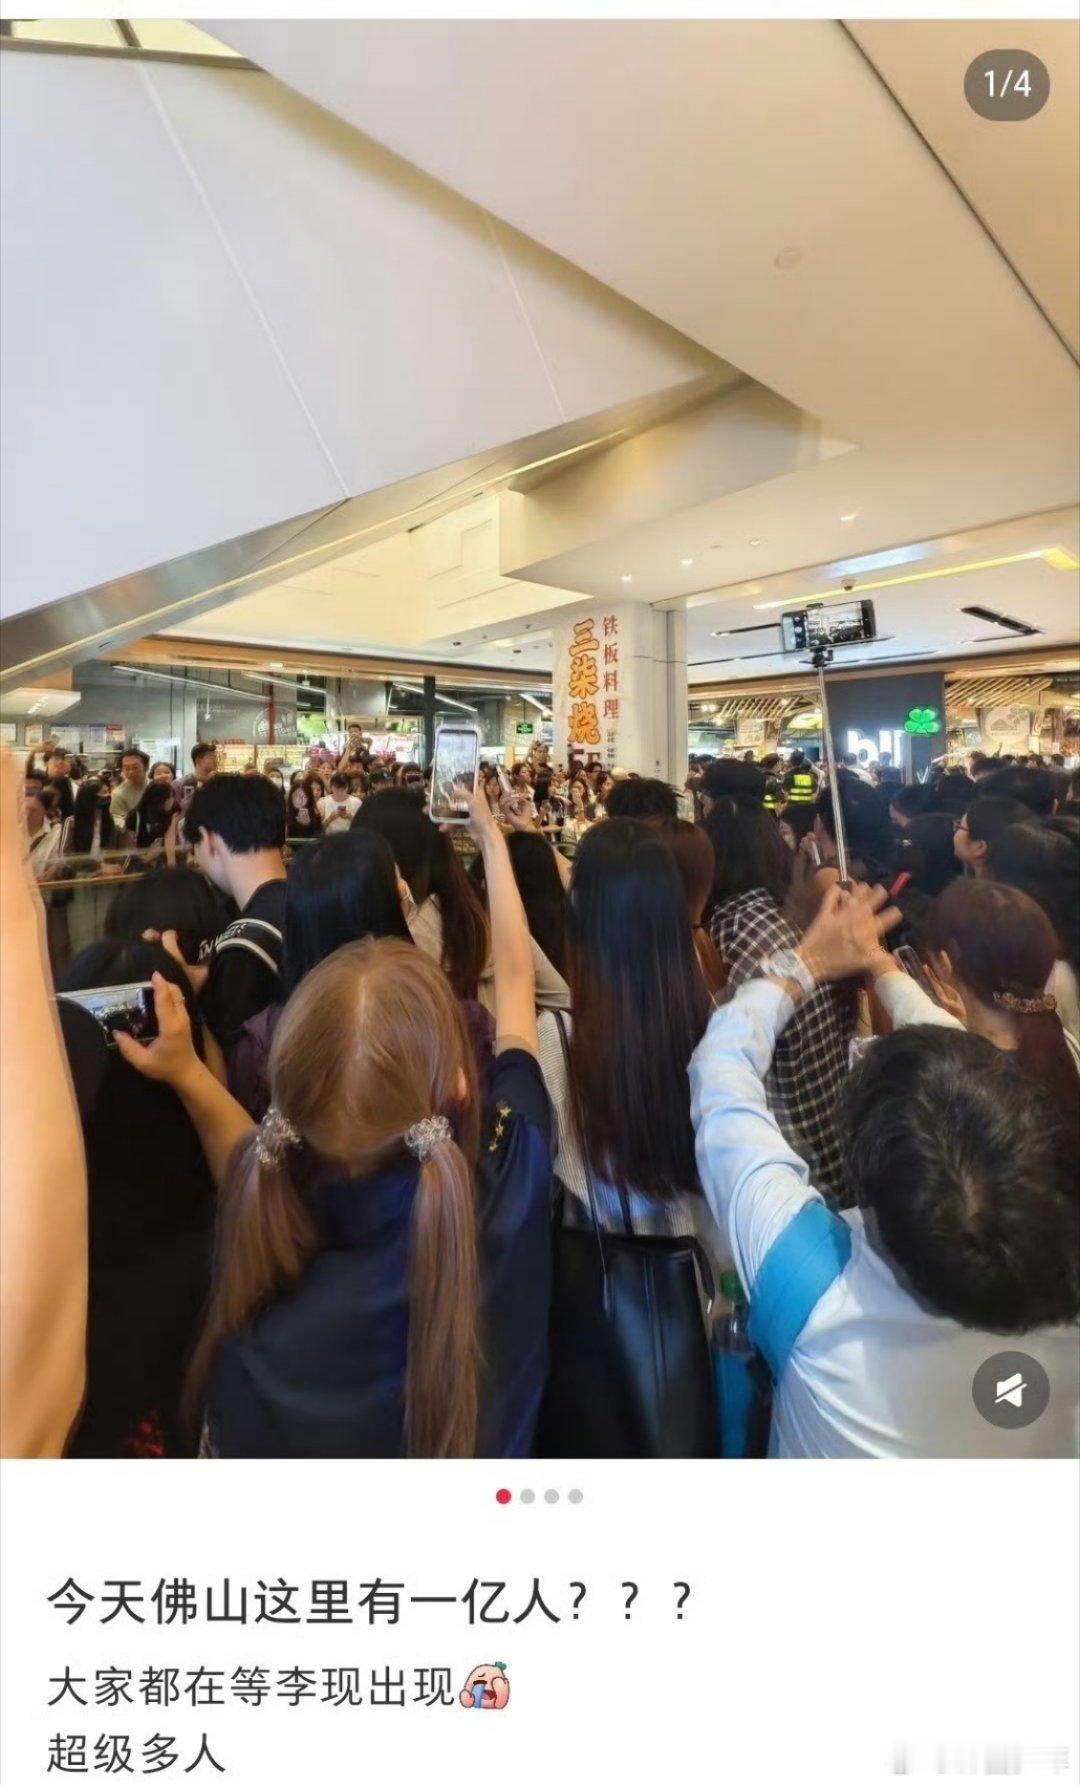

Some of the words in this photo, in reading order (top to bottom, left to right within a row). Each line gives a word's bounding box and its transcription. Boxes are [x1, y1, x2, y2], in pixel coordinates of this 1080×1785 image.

[568, 618, 600, 745] 三柒烧
[603, 615, 620, 719] 铁板料理
